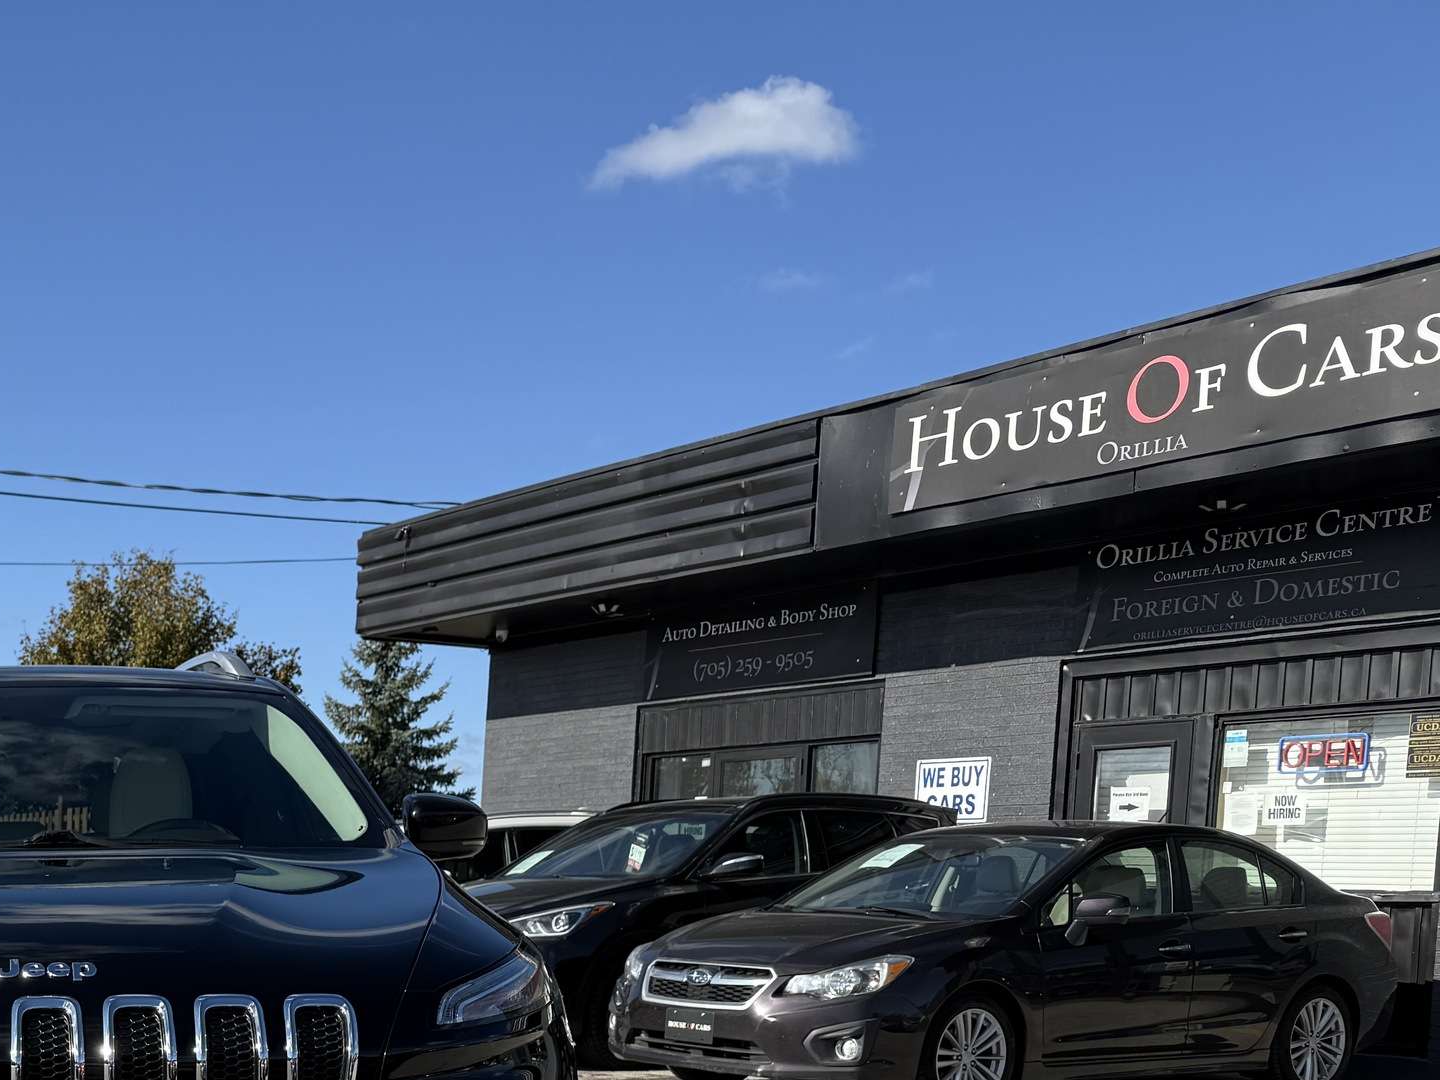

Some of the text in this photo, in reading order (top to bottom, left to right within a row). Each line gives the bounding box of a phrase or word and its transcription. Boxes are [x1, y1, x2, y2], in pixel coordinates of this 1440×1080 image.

[903, 312, 1440, 474] HOUSE OF CARS
[1097, 434, 1188, 465] ORILLIA
[1096, 503, 1432, 569] ORILLIA SERVICE CENTRE
[1153, 547, 1353, 583] COMPLETE AUTO REPAIR & SERVICES
[1111, 570, 1401, 622] FOREIGN & DOMESTIC
[662, 603, 857, 643] AUTO DETAILING & BODY SHOP
[693, 655, 732, 683] (705)
[735, 656, 762, 677] 259
[775, 650, 814, 673] 9505
[1416, 722, 1440, 731] UCD
[1282, 737, 1364, 768] OPEN
[923, 765, 985, 788] WE BUY
[1268, 807, 1301, 820] HIRING
[1274, 795, 1298, 807] NOW
